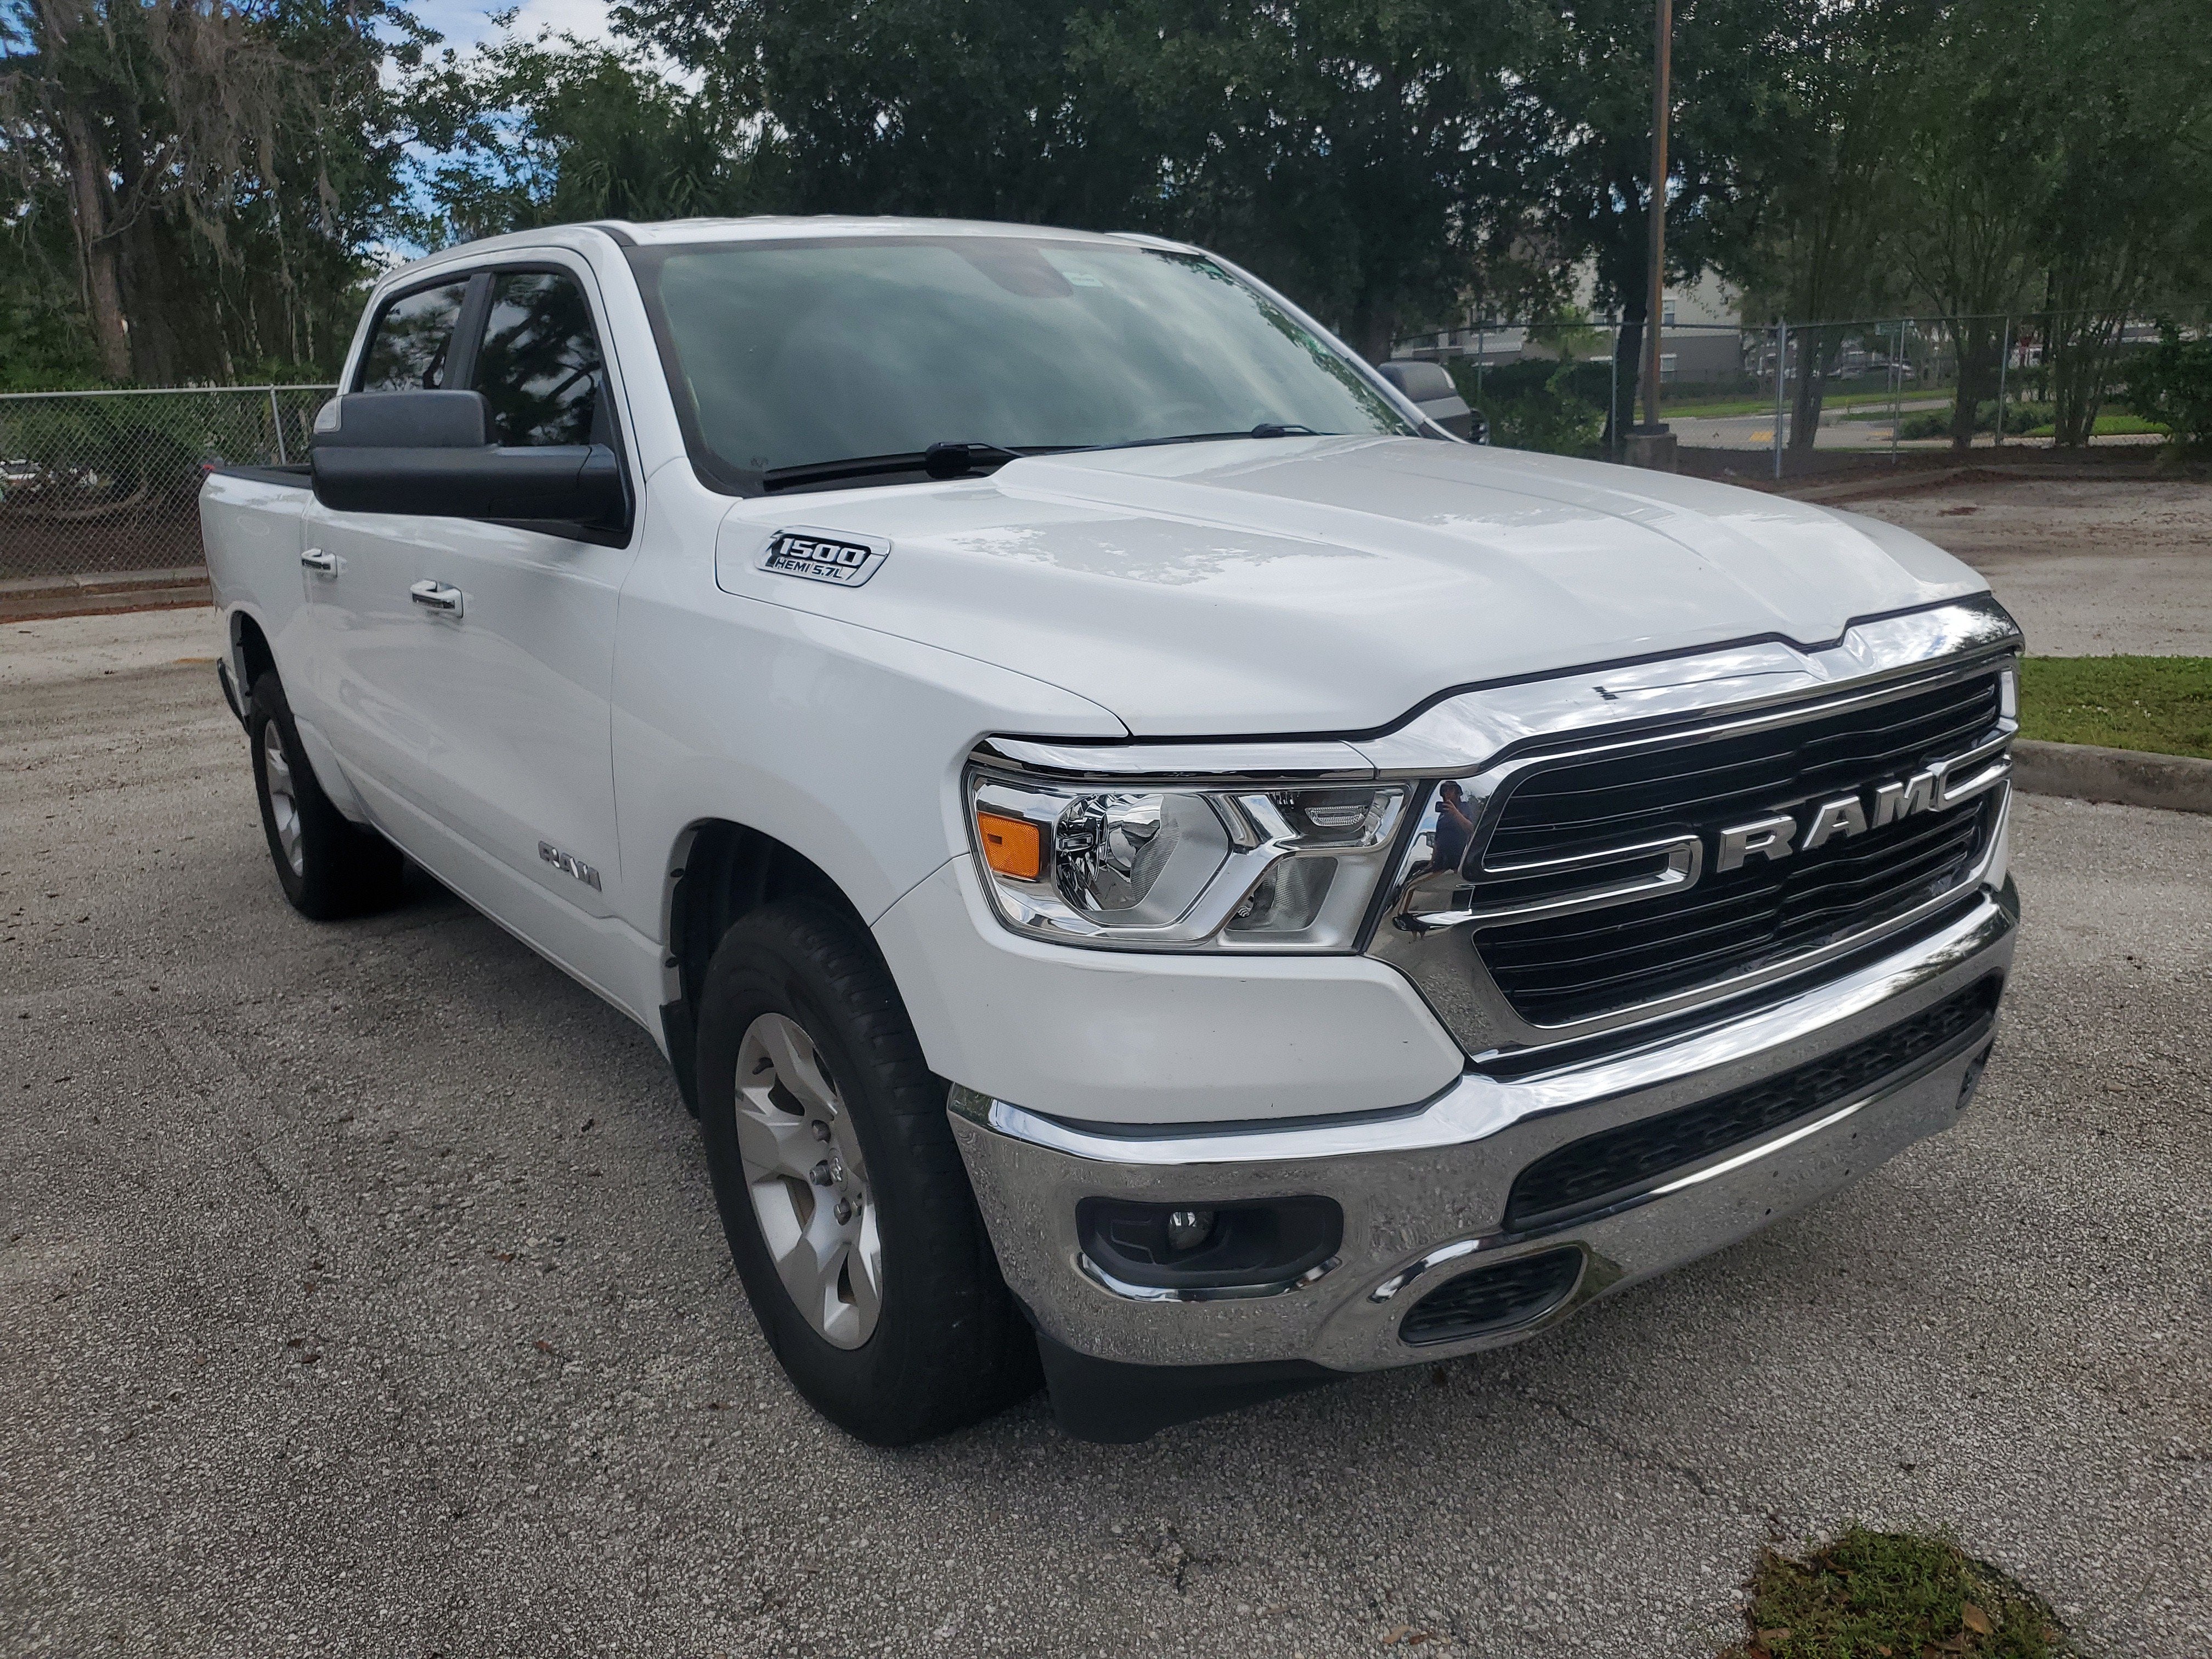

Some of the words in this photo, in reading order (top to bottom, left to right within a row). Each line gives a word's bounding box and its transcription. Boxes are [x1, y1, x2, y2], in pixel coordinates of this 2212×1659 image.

[775, 557, 810, 573] HEMI
[811, 565, 842, 579] 5.7L
[780, 538, 866, 566] 1500
[1716, 771, 1933, 872] RAM
[538, 840, 602, 892] RAM
